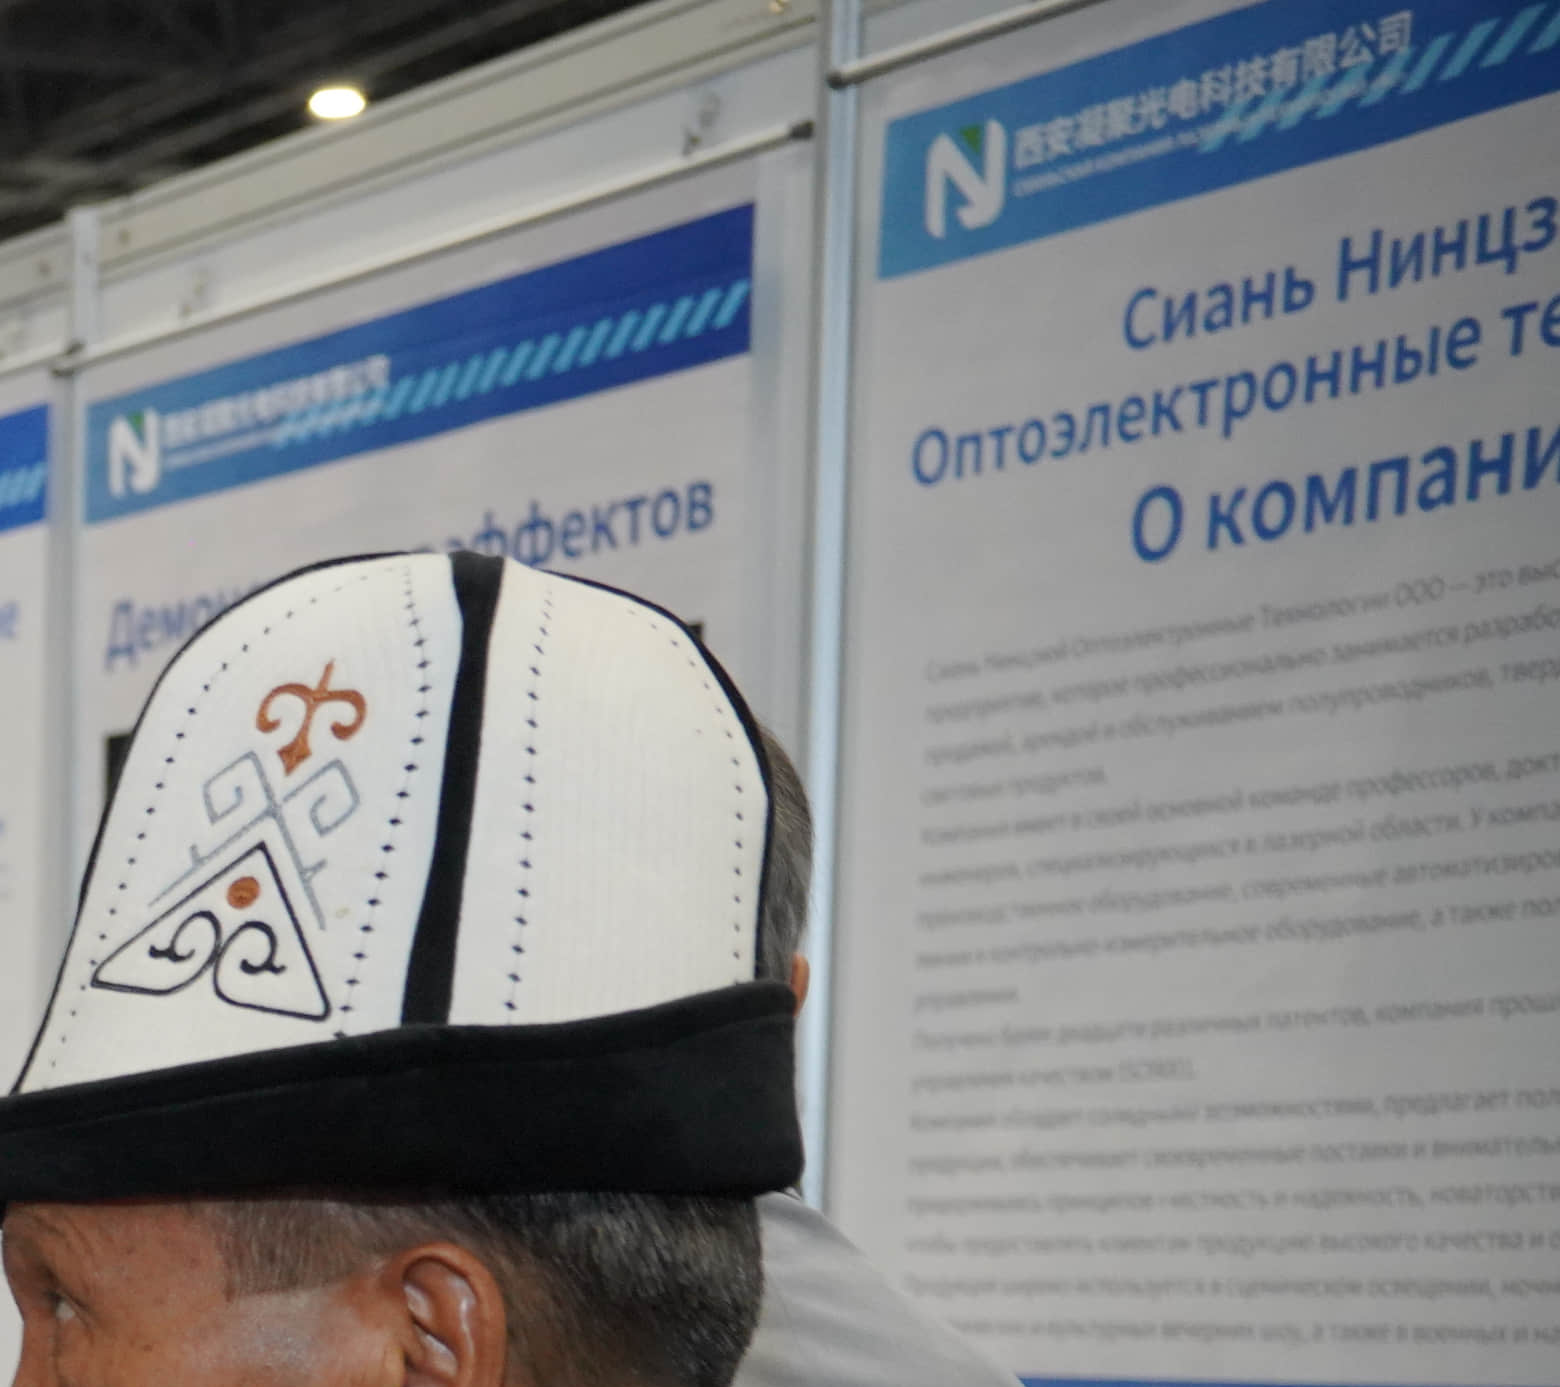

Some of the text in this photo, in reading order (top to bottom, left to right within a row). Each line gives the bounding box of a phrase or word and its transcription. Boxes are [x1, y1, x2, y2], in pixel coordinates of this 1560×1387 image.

[1123, 266, 1317, 350] Сиань
[910, 315, 1483, 486] Оптоэлектронные
[446, 480, 715, 569] ффектов
[1130, 484, 1187, 564] О
